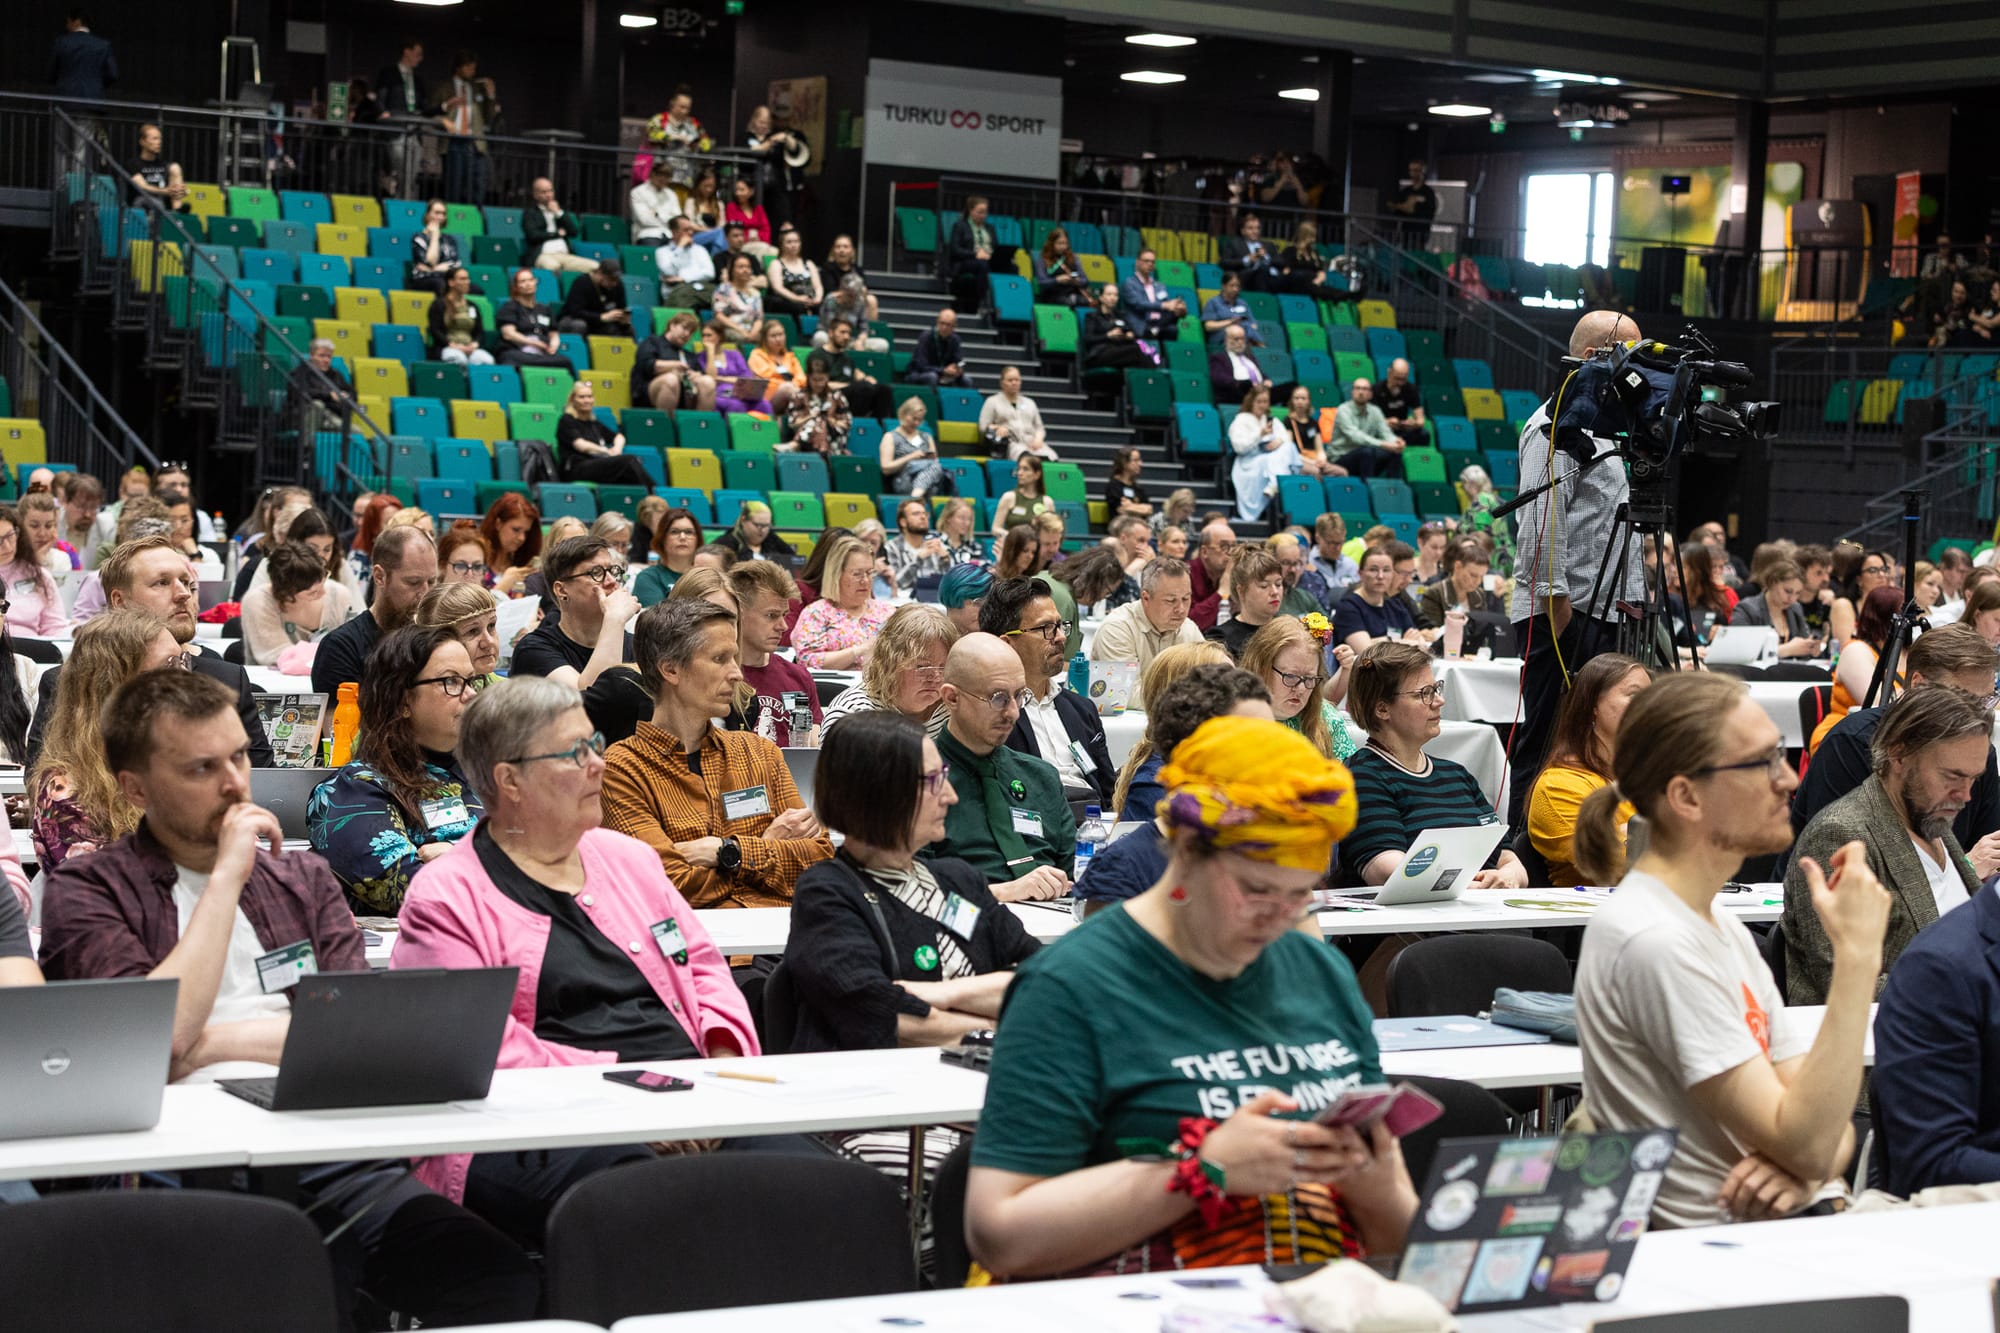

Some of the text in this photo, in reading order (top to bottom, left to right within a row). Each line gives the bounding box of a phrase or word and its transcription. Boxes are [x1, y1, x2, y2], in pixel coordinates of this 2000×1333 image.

[883, 104, 1046, 135] TURKU SPORT
[757, 697, 785, 715] OMEN
[1171, 1038, 1358, 1081] THE FUTURE
[1197, 1086, 1235, 1119] IS
